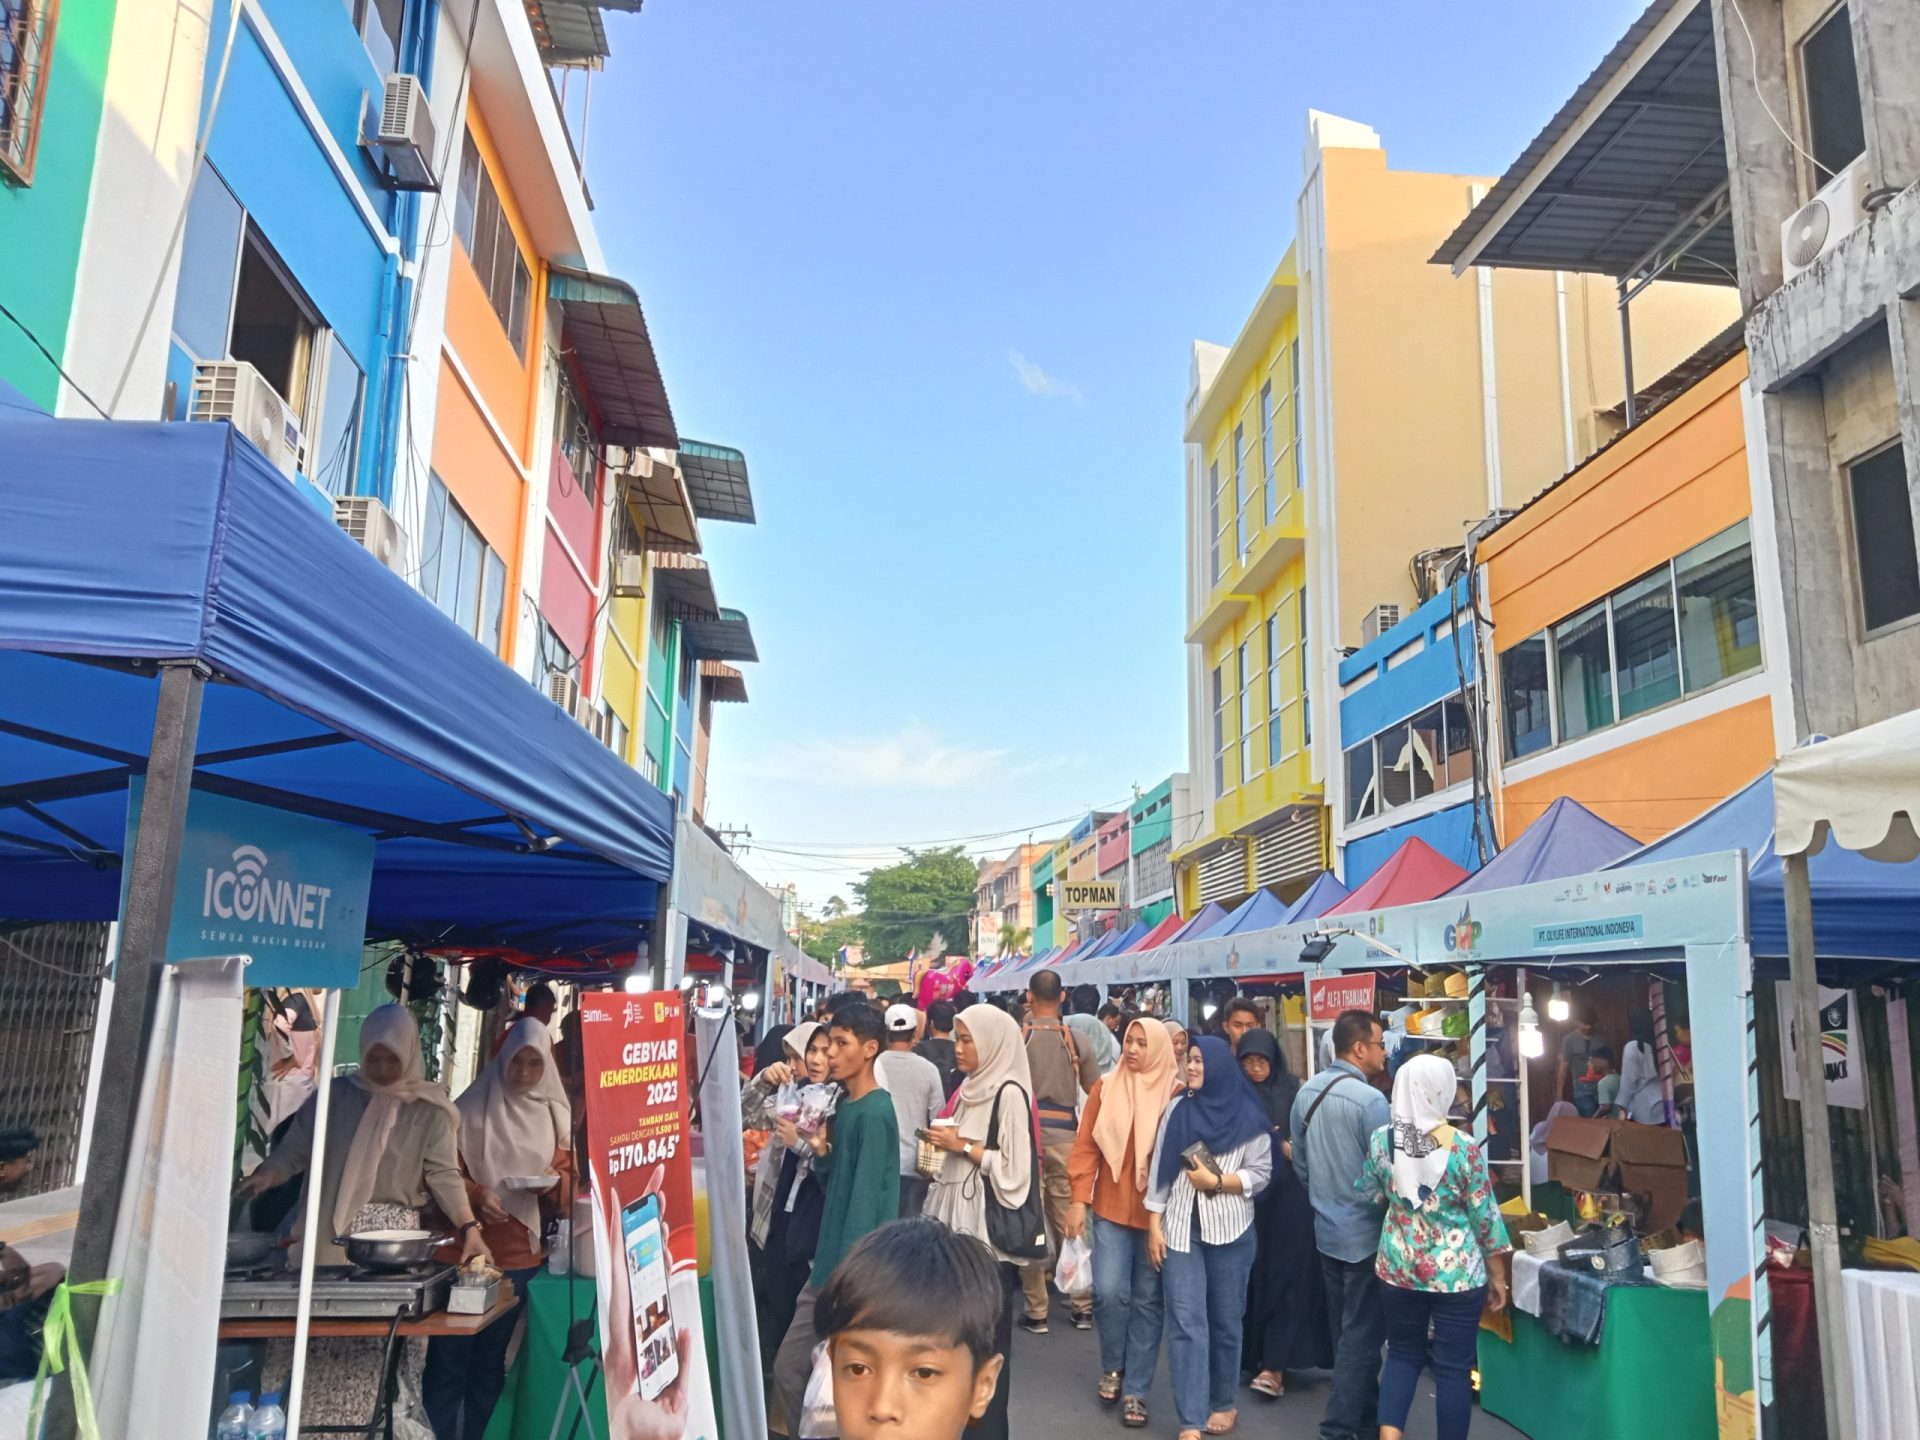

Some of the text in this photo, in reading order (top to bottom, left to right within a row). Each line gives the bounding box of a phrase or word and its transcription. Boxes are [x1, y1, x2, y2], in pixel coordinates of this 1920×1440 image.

[203, 867, 331, 930] ICONNET
[1065, 887, 1115, 903] TOPMAN
[200, 929, 244, 943] SEMUA
[252, 934, 288, 947] MAKIN
[1538, 930, 1547, 942] PT.
[1565, 924, 1604, 940] INTERNATIONAL
[1604, 920, 1635, 936] INDONESIA
[1327, 990, 1341, 1009] ALFA
[664, 1005, 680, 1018] PLN
[622, 1038, 678, 1066] GEBYAR
[599, 1061, 678, 1089] KEMERDEKAAN
[646, 1079, 678, 1106] 2023
[638, 1110, 679, 1127] TAMBAH DAYA
[609, 1133, 631, 1147] SAMPAI
[631, 1127, 655, 1142] DENGAN
